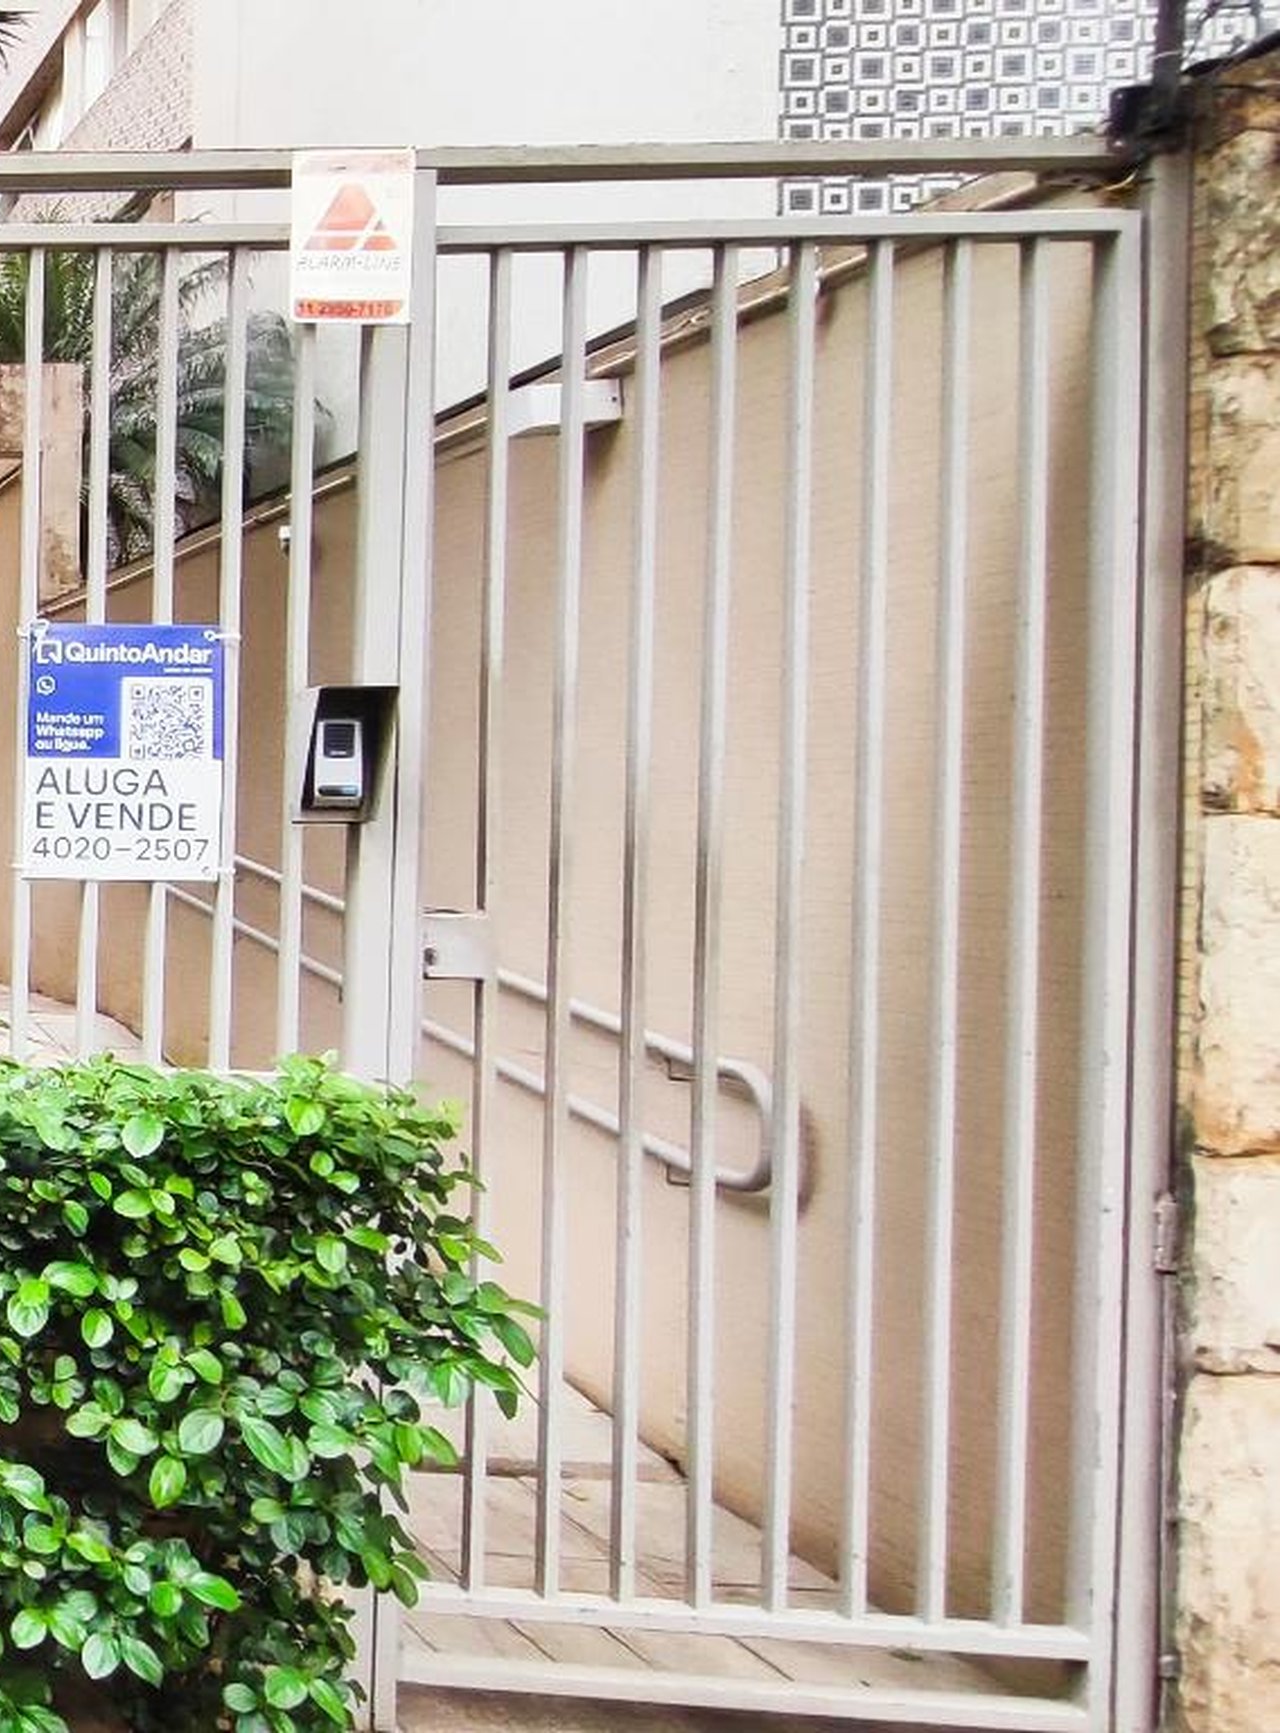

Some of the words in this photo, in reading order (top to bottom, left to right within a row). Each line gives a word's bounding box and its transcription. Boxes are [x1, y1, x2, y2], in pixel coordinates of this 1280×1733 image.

[65, 643, 213, 665] QuintoAndar
[36, 711, 81, 724] Mande
[83, 714, 105, 725] um
[35, 739, 53, 750] ou
[36, 767, 169, 797] ALUGA
[36, 802, 55, 829] E
[67, 803, 197, 832] VENDE
[33, 837, 210, 862] 4020-2507
